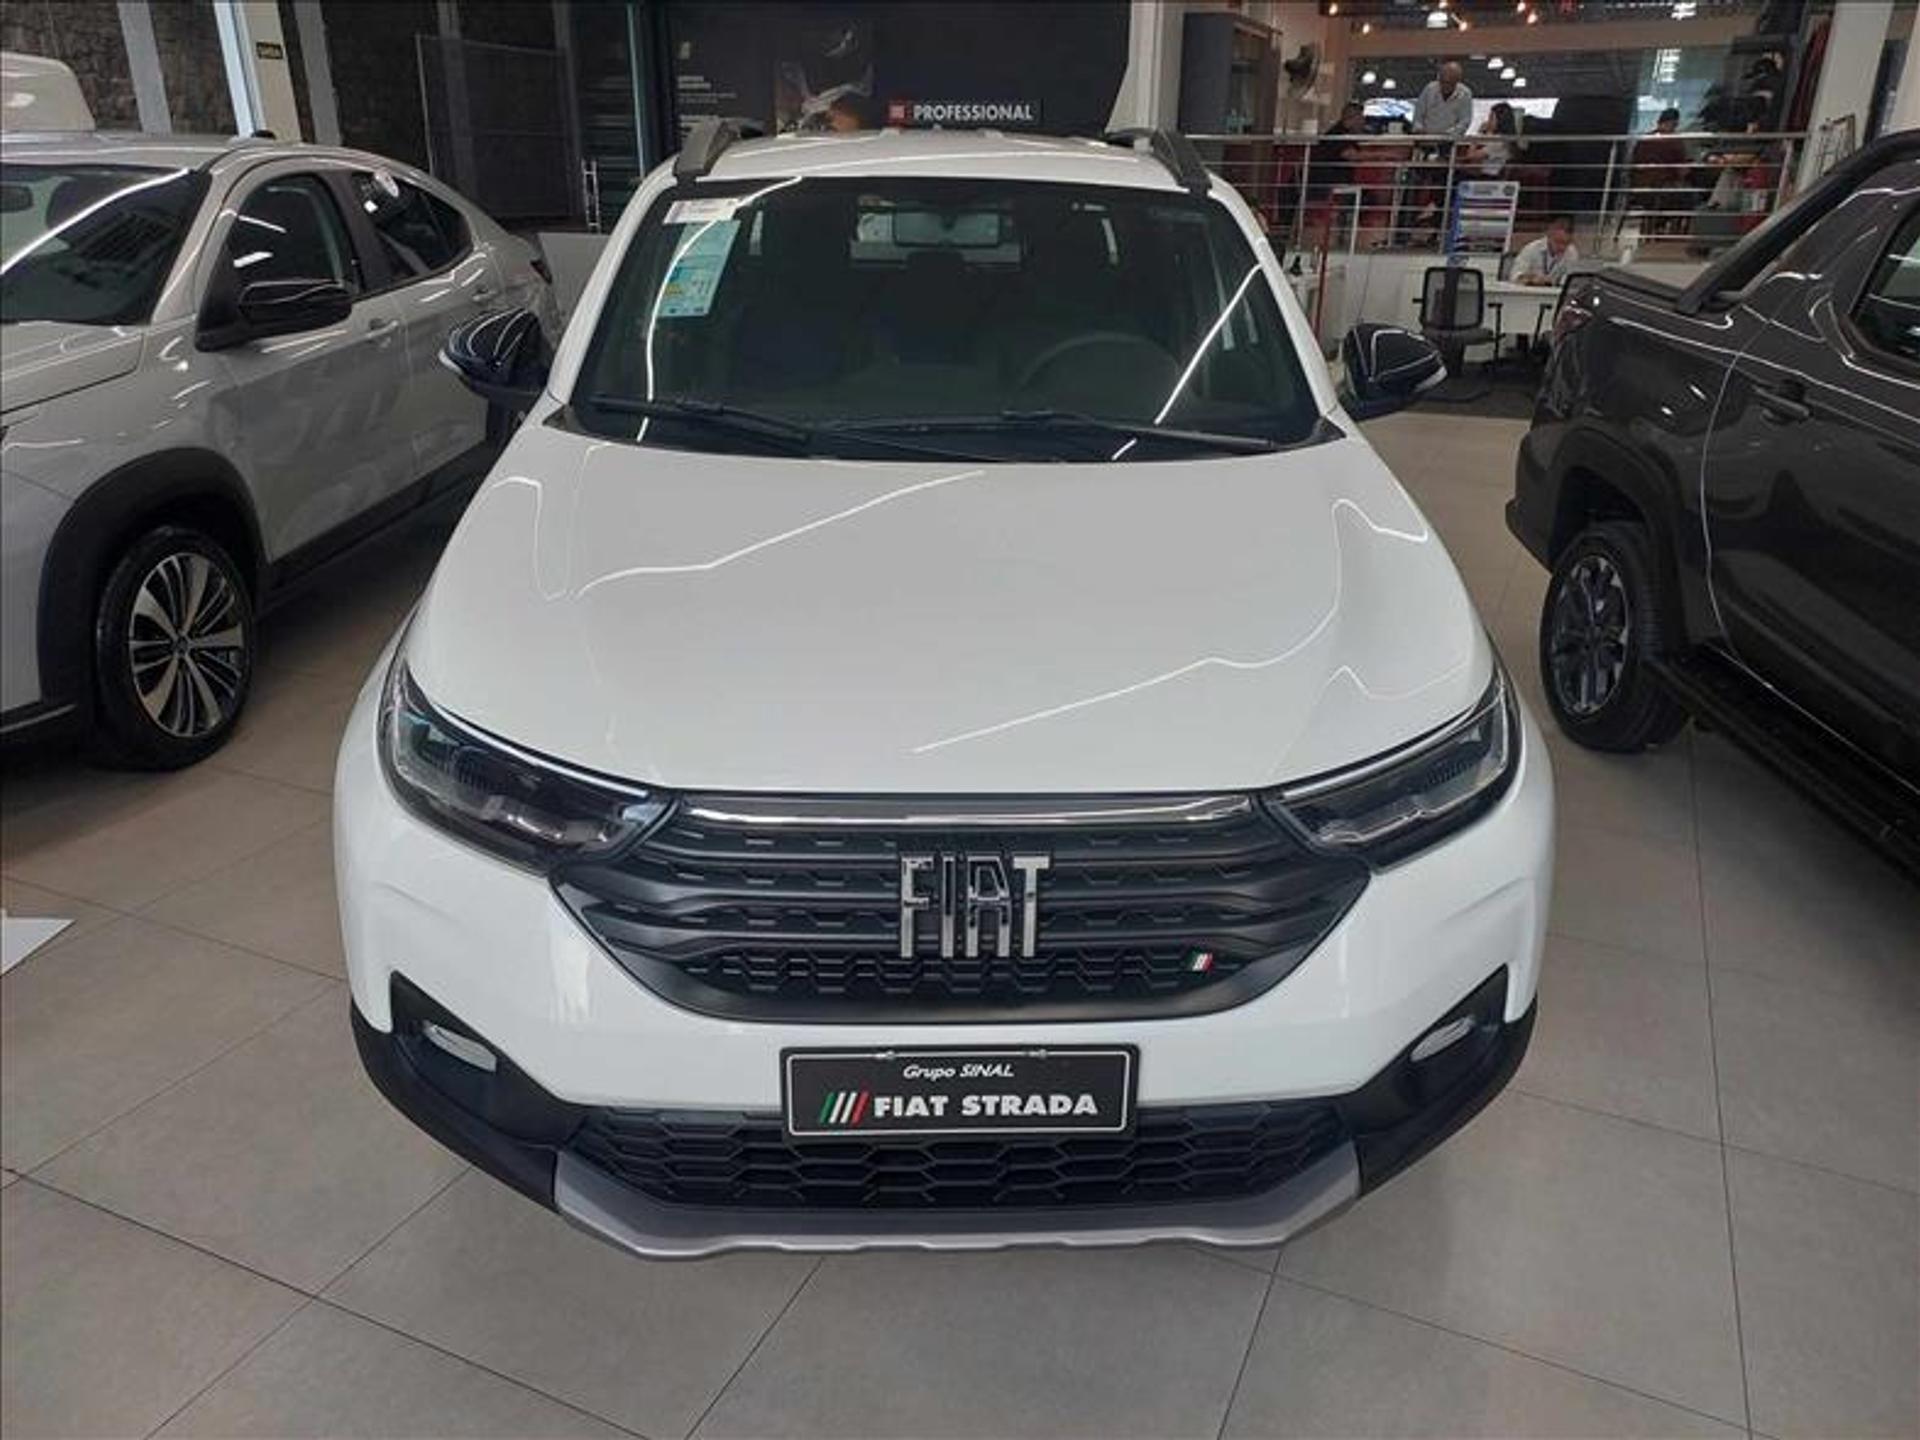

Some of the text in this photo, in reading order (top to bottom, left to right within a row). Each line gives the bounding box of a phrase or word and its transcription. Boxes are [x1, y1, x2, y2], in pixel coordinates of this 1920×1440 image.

[913, 104, 1033, 121] PROFESSIONAL
[901, 856, 1050, 958] FIAT
[903, 1063, 1014, 1081] Grupo SINAL
[874, 1094, 1098, 1118] FIAT STRADA
